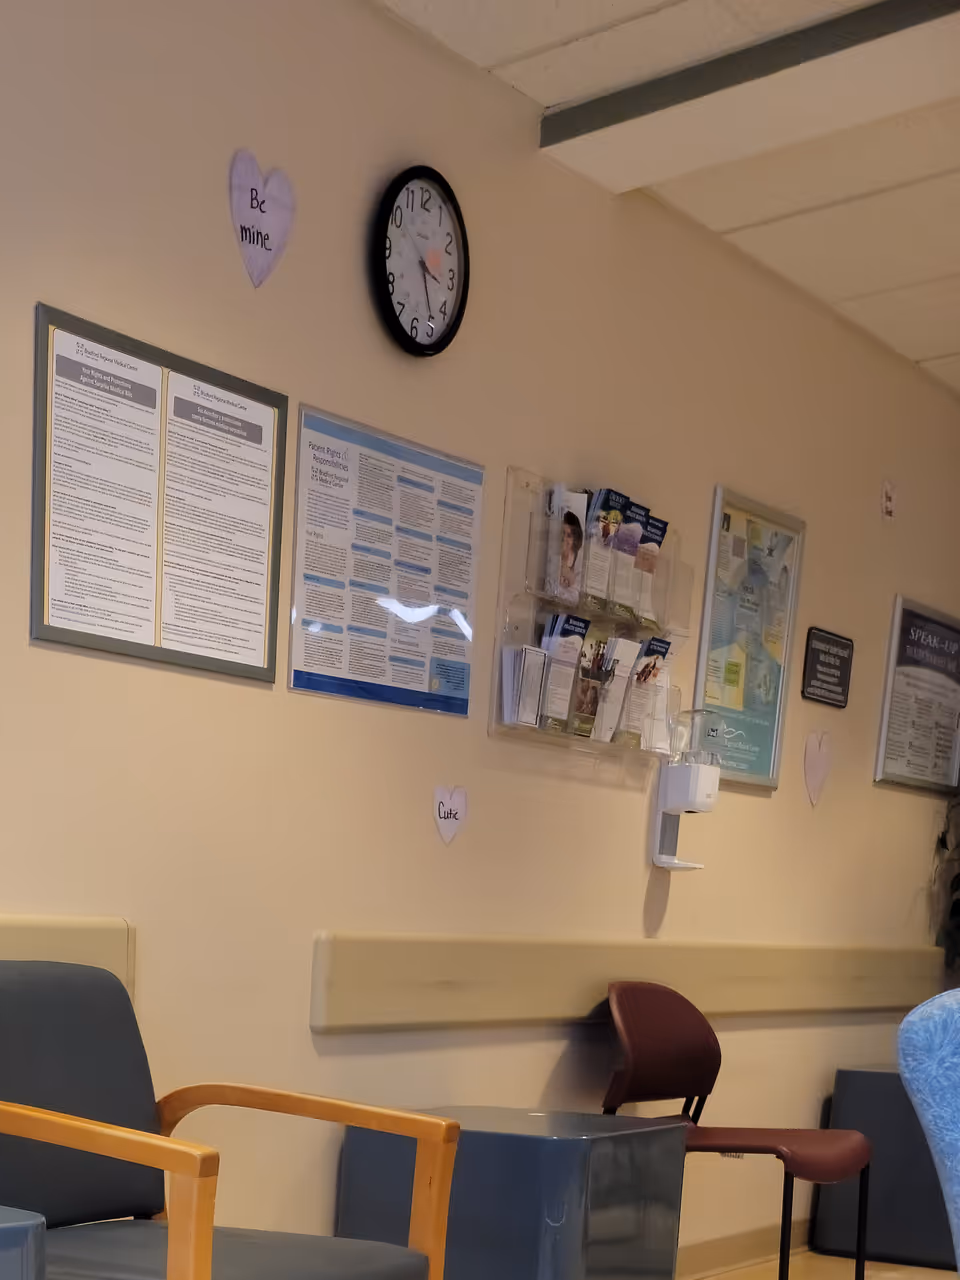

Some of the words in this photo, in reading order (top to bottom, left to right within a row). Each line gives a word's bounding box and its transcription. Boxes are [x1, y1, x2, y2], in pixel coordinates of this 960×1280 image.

[250, 188, 267, 213] Be
[405, 187, 415, 212] 11
[420, 186, 431, 213] 12
[240, 224, 272, 251] mine
[445, 232, 453, 256] 2
[447, 269, 455, 291] 3
[397, 301, 405, 318] 7
[439, 300, 448, 321] 4
[410, 317, 419, 340] 6
[426, 314, 435, 338] 5
[308, 441, 326, 453] Patient
[326, 446, 341, 459] Rights
[312, 454, 349, 472] Responsibilities
